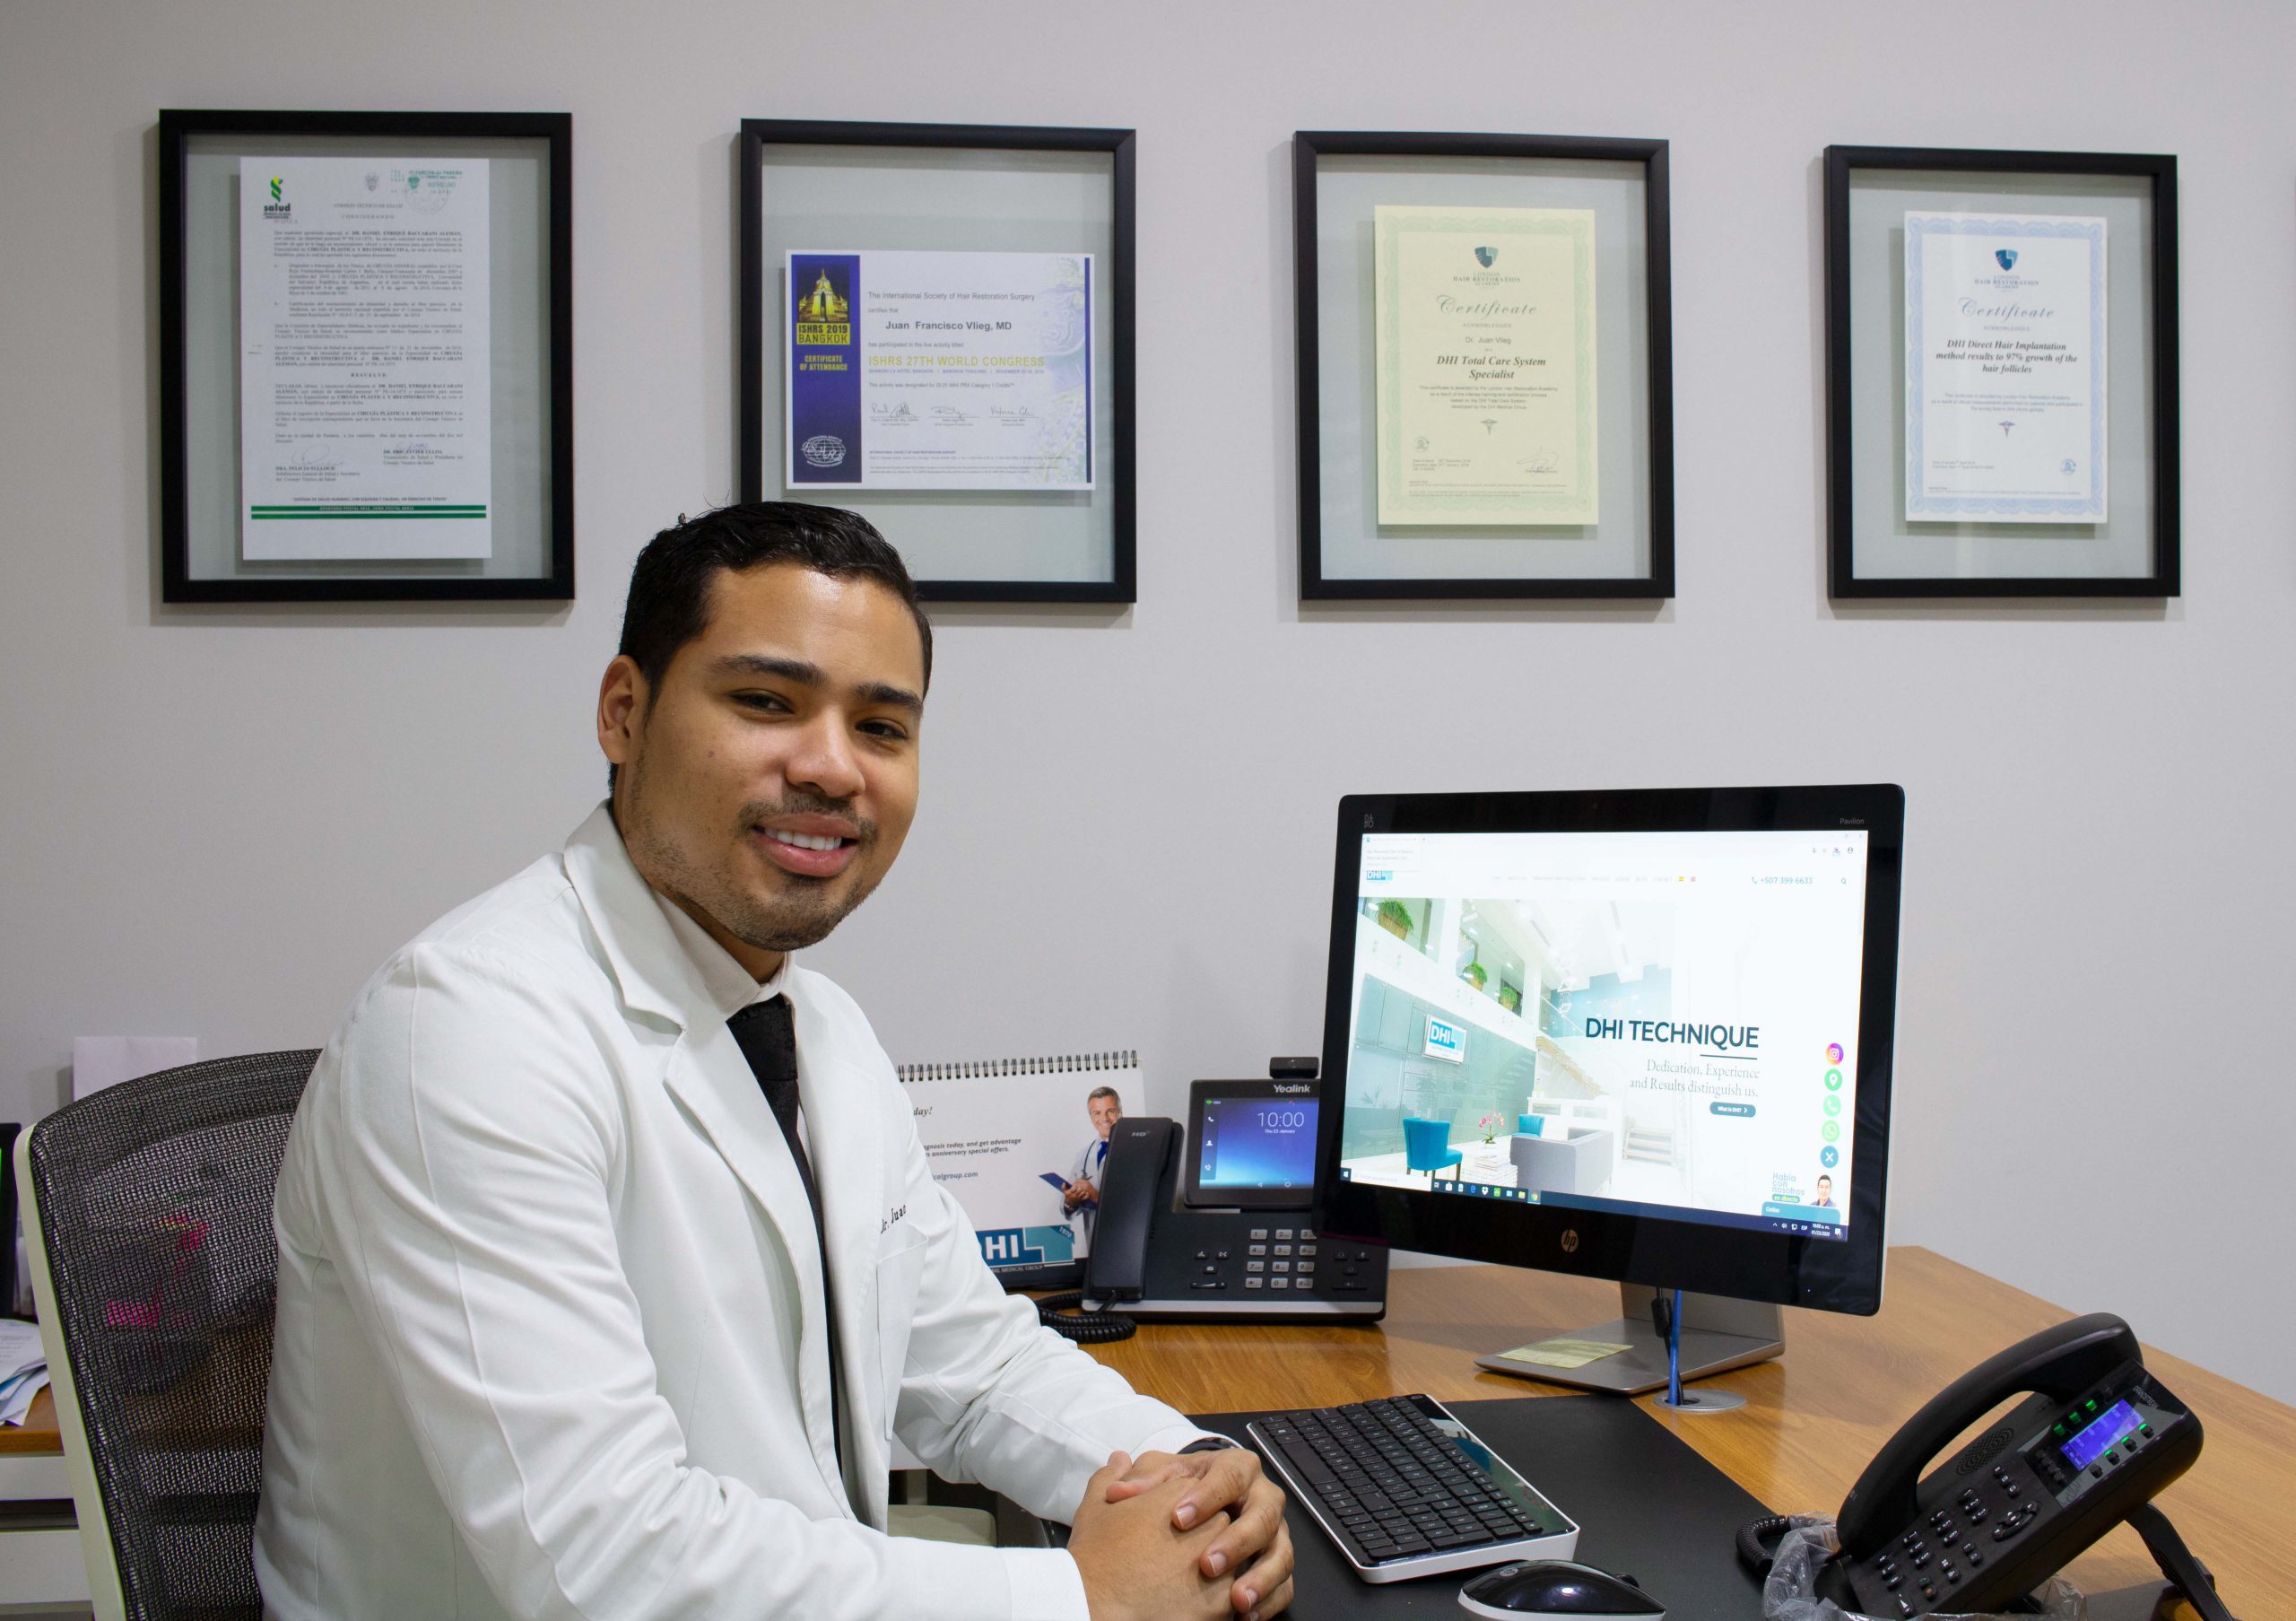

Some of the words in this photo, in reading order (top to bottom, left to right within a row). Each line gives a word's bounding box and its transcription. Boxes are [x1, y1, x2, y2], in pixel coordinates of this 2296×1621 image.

[263, 203, 291, 212] salud
[924, 292, 947, 301] Society
[972, 292, 1009, 301] Restoration
[1010, 292, 1035, 302] Surgery
[1436, 294, 1537, 320] Certificate
[1958, 297, 2054, 322] Certificate
[798, 325, 823, 334] ISHRS
[826, 325, 848, 334] 2019
[885, 321, 909, 330] Juan
[915, 321, 963, 330] Francisco
[966, 321, 993, 332] Vlieg,
[996, 321, 1013, 330] MD
[798, 334, 848, 344] BANGKOK
[1947, 339, 1966, 348] DHI
[1968, 339, 1993, 349] Direct
[1995, 340, 2013, 350] Hair
[2015, 341, 2066, 352] Implantation
[868, 356, 903, 366] ISHRS
[906, 356, 934, 366] 27TH
[937, 356, 978, 367] WORLD
[982, 356, 1045, 367] CONGRESS
[1436, 355, 1459, 365] DHI
[1461, 355, 1487, 365] Total
[1488, 356, 1511, 366] Care
[1513, 356, 1546, 368] System
[1935, 352, 1966, 360] method
[1968, 353, 1994, 361] results
[2005, 353, 2023, 361] 97%
[2025, 353, 2053, 363] growth
[2055, 354, 2064, 364] of
[2065, 354, 2078, 362] the
[1468, 369, 1515, 380] Specialist
[1982, 363, 1999, 372] hair
[2000, 364, 2032, 375] follicles
[1761, 876, 1778, 885] +507
[1431, 1024, 1451, 1044] DHI
[1586, 1017, 1623, 1040] DHI
[1629, 1020, 1760, 1050] TECHNIQUE
[1706, 1063, 1760, 1081] Experience
[1274, 1084, 1310, 1093] Yealink
[1630, 1076, 1648, 1089] and
[1649, 1078, 1685, 1093] Results
[1688, 1082, 1742, 1099] distinguish
[1744, 1087, 1759, 1098] us.
[913, 1106, 933, 1118] day!
[1257, 1112, 1304, 1127] 10:00
[990, 1137, 1022, 1146] advantage
[1772, 1172, 1796, 1182] Habla
[1772, 1186, 1805, 1196] nosotros
[1059, 1226, 1073, 1238] 1970
[985, 1234, 1019, 1259] HI
[1562, 1229, 1578, 1252] hp
